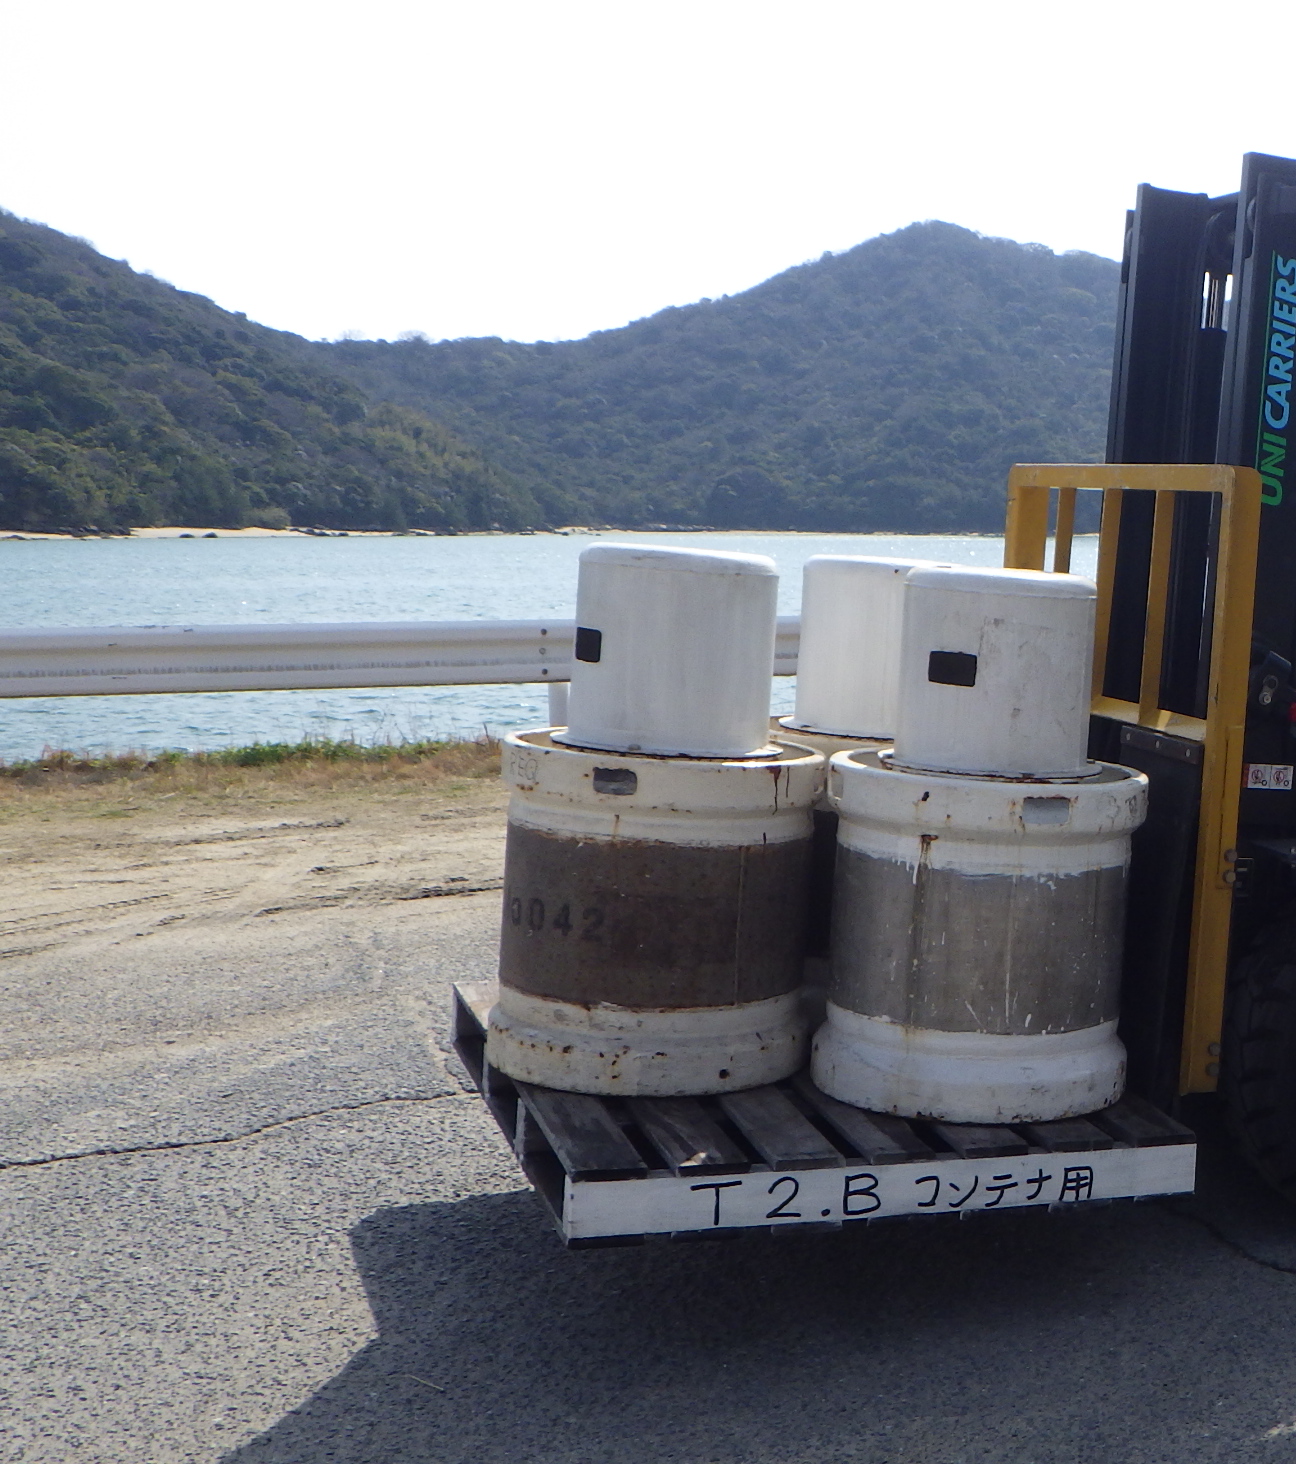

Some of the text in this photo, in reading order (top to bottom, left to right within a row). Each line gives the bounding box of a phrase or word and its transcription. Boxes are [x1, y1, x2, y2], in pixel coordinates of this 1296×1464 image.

[914, 1165, 1093, 1207] コンテナ用
